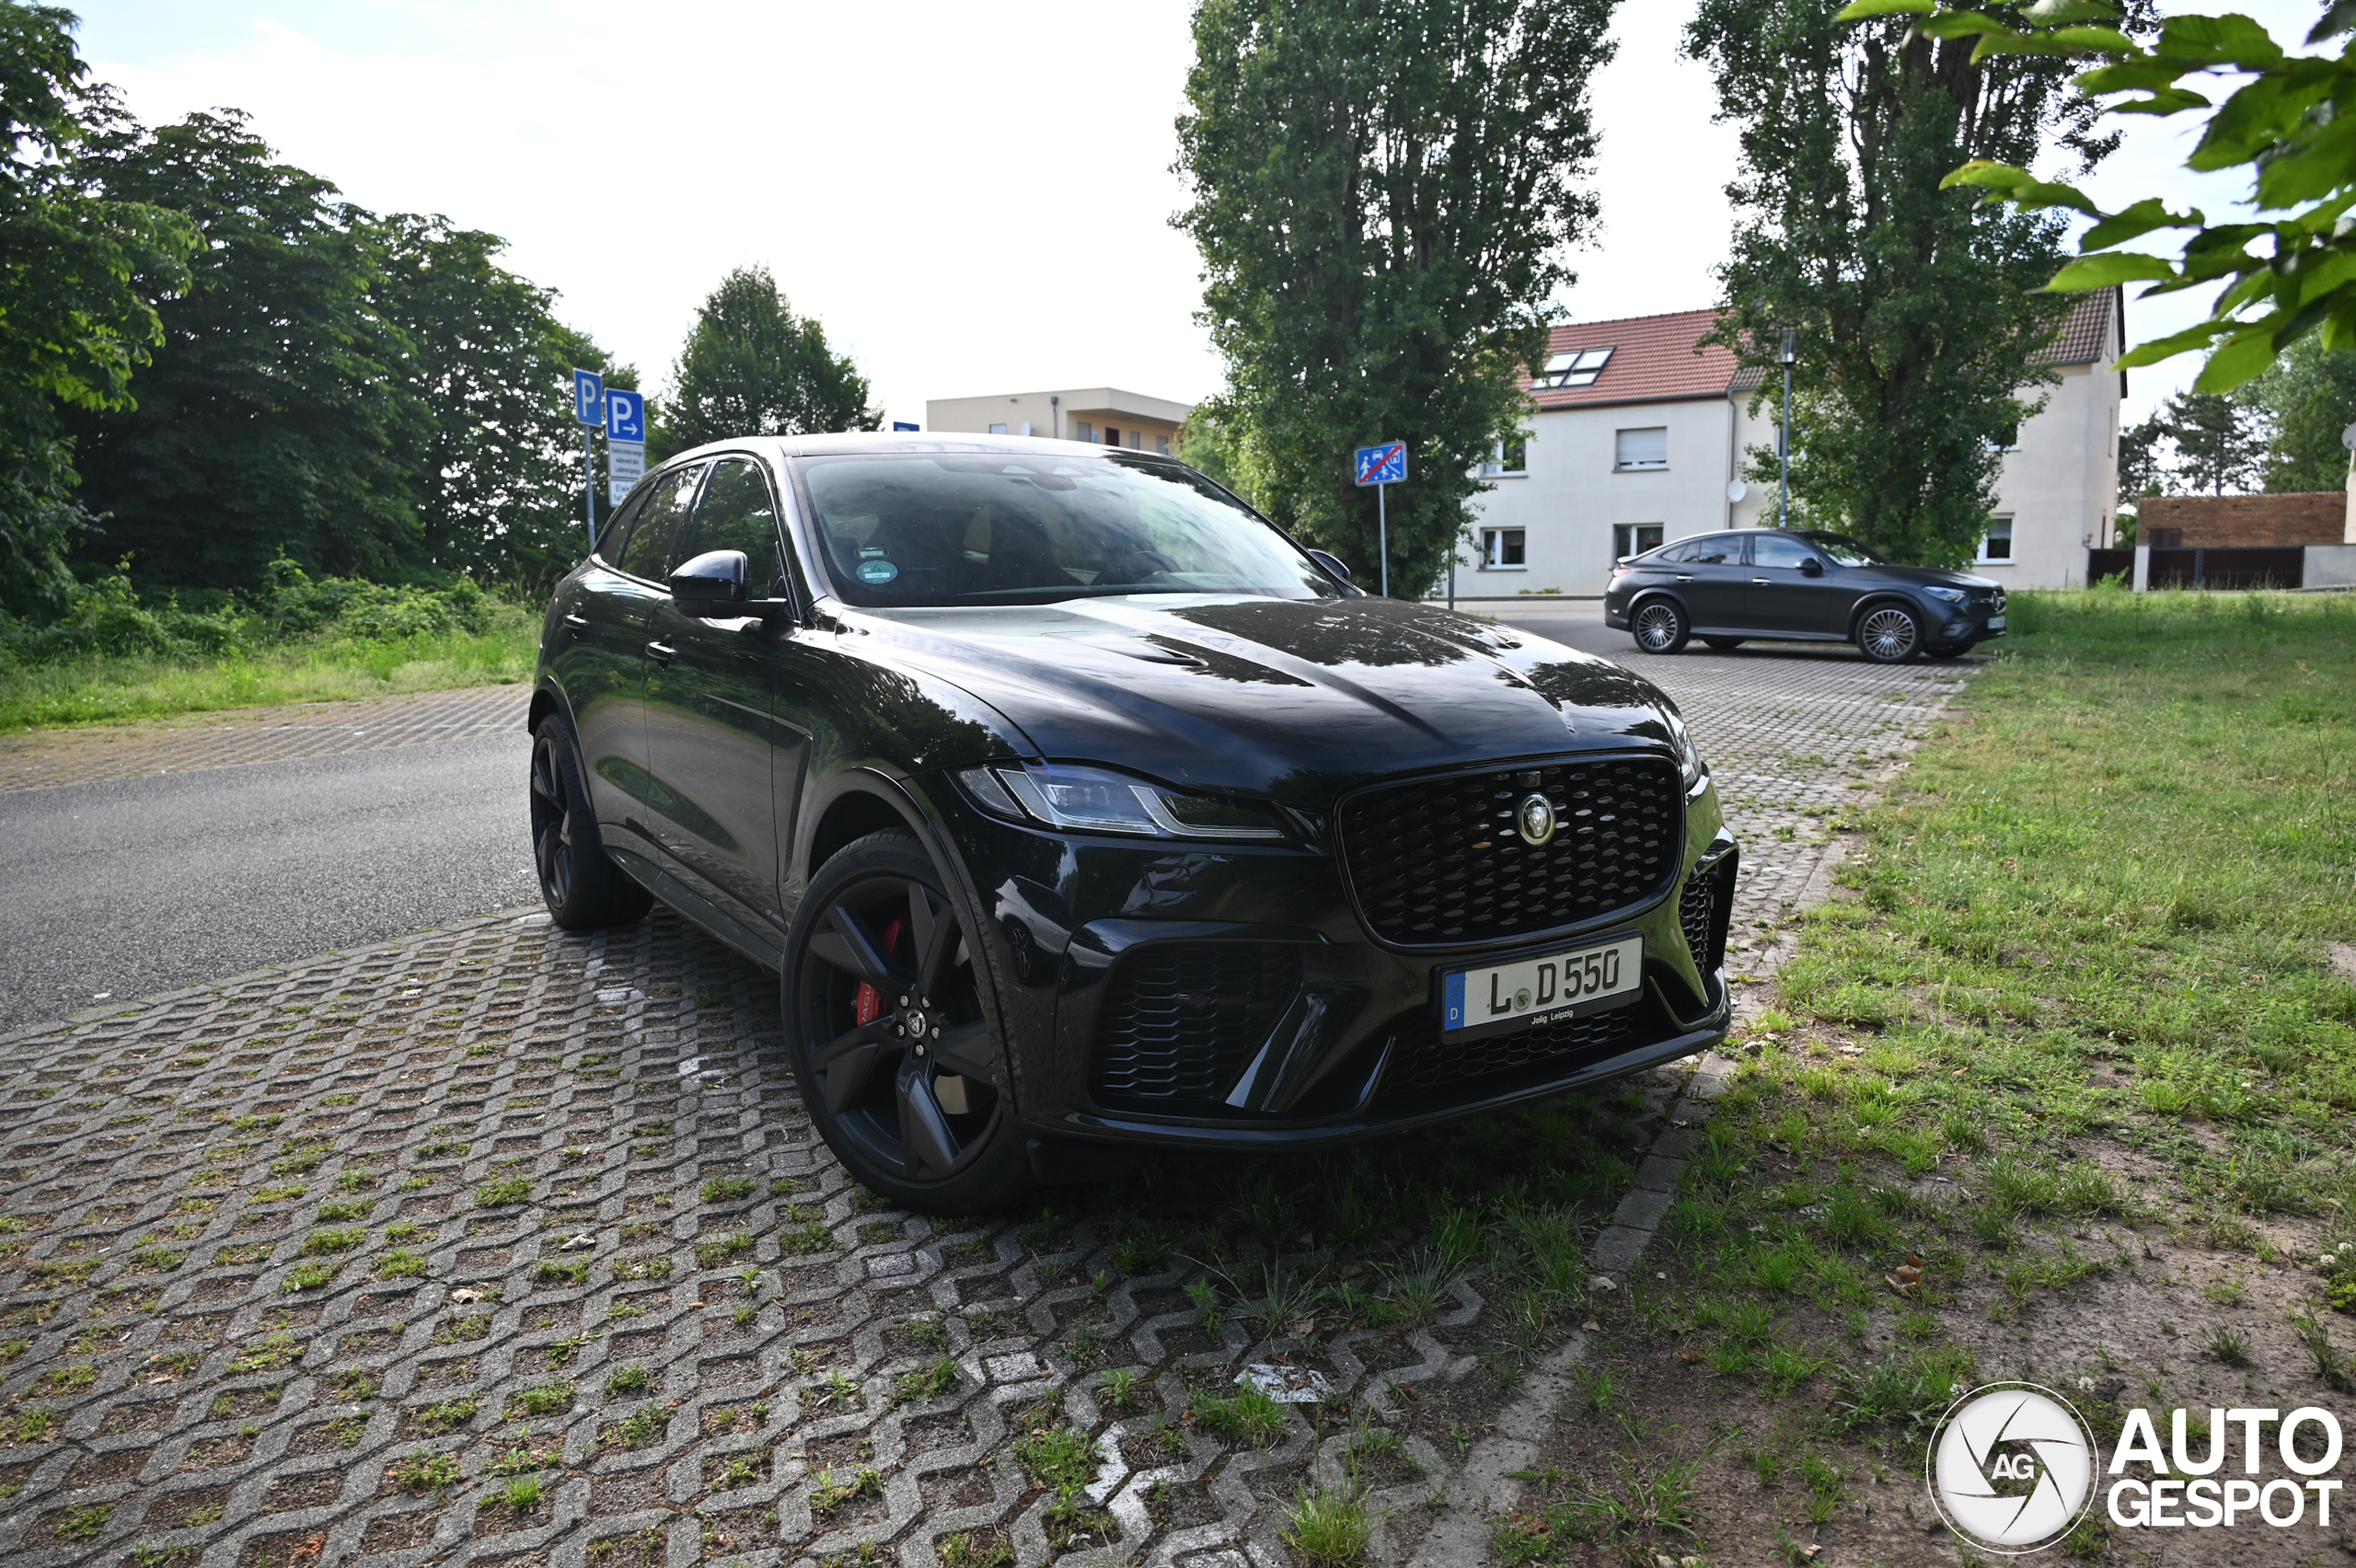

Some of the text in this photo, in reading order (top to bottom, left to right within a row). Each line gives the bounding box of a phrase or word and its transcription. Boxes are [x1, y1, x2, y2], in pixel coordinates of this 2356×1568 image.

[581, 377, 596, 417] P
[611, 396, 633, 433] P
[616, 484, 629, 492] Elek
[872, 563, 882, 572] 4
[1490, 948, 1620, 1015] L D 550
[861, 984, 872, 1023] JAGU
[1449, 1008, 1459, 1020] D
[1530, 1009, 1574, 1025] Jolig Leipzig
